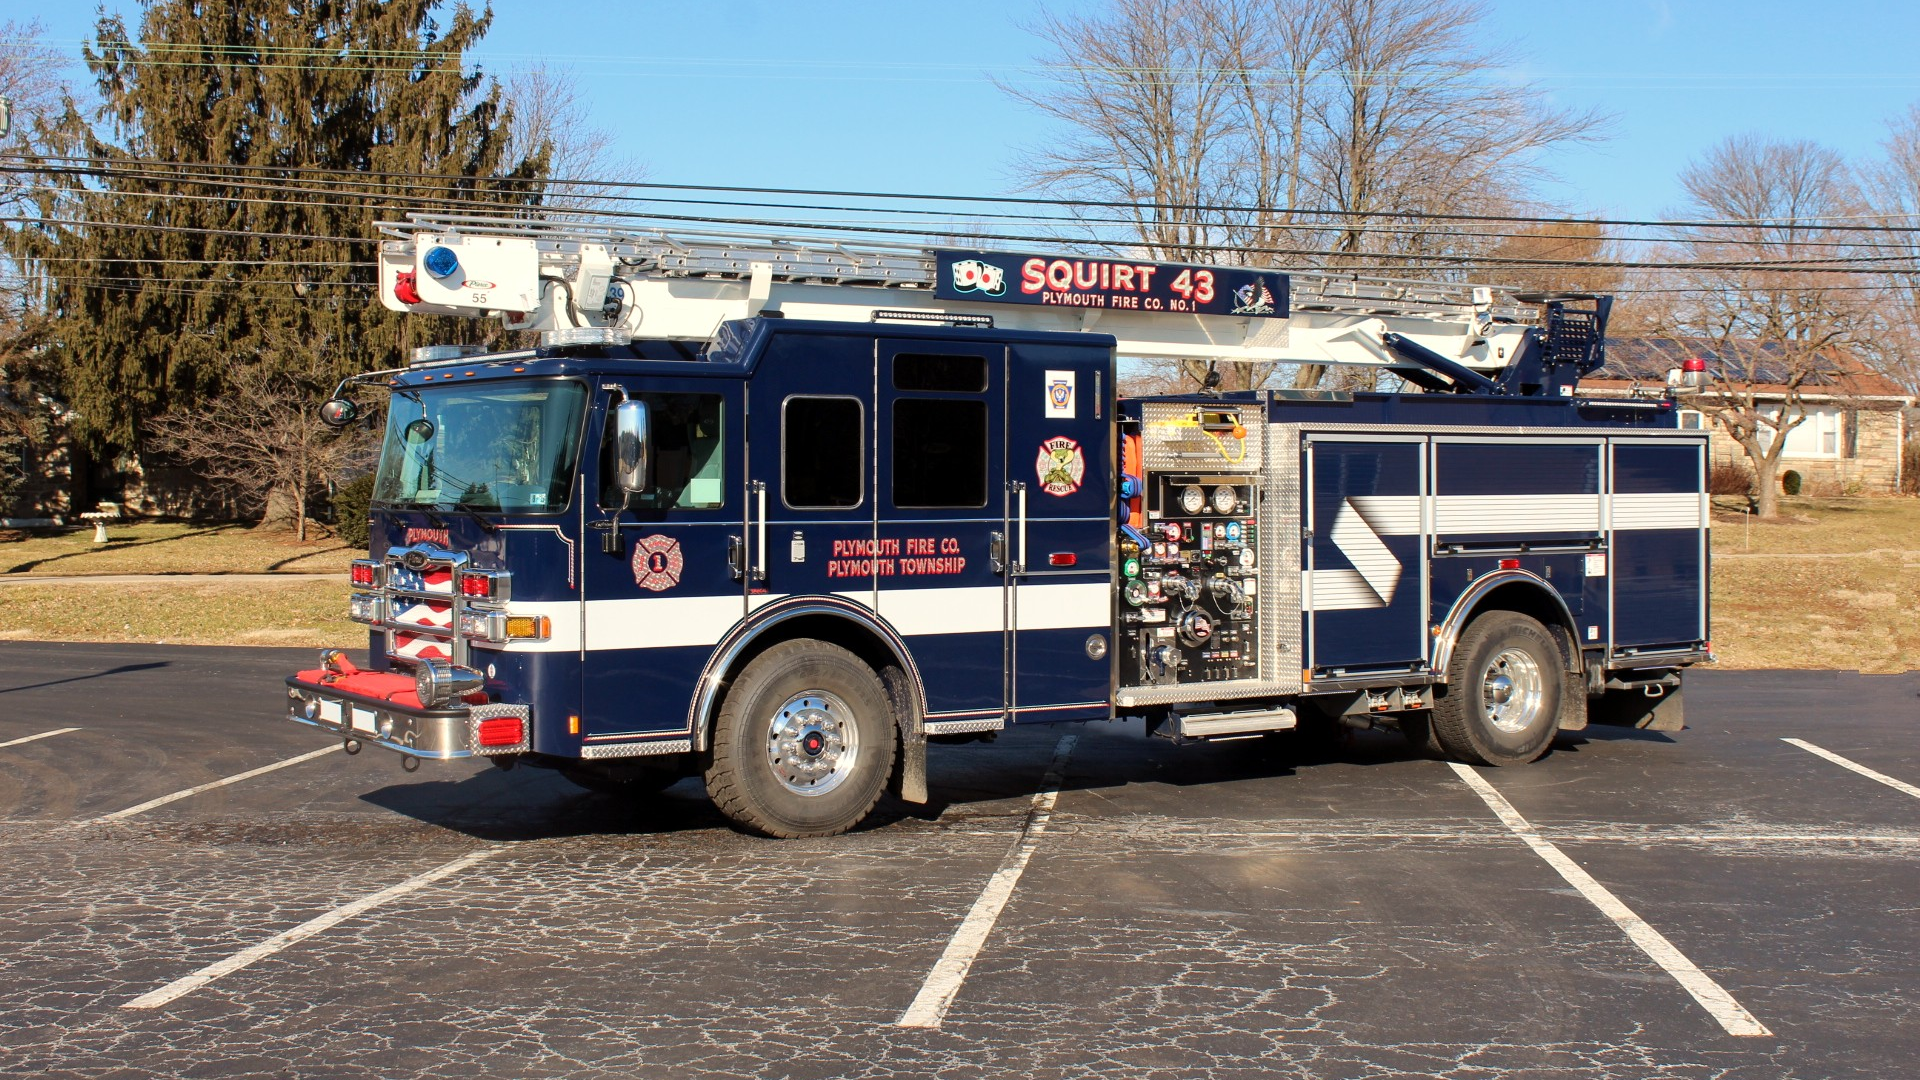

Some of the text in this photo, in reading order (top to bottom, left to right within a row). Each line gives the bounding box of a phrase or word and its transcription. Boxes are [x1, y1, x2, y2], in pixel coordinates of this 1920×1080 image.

[1021, 257, 1215, 304] SQUIRT 43
[472, 292, 487, 304] 55
[1042, 291, 1105, 308] PLYMOUTH
[1112, 295, 1139, 309] FIRE
[1144, 298, 1164, 310] CO.
[1049, 440, 1072, 450] FIRE
[1048, 483, 1073, 492] RESCUE
[407, 527, 449, 547] PLYMOUTH
[833, 537, 961, 557] PLYMOUTH FIRE CO.
[652, 554, 664, 572] 1
[827, 557, 967, 578] PLYMOUTH TOWNSHIP
